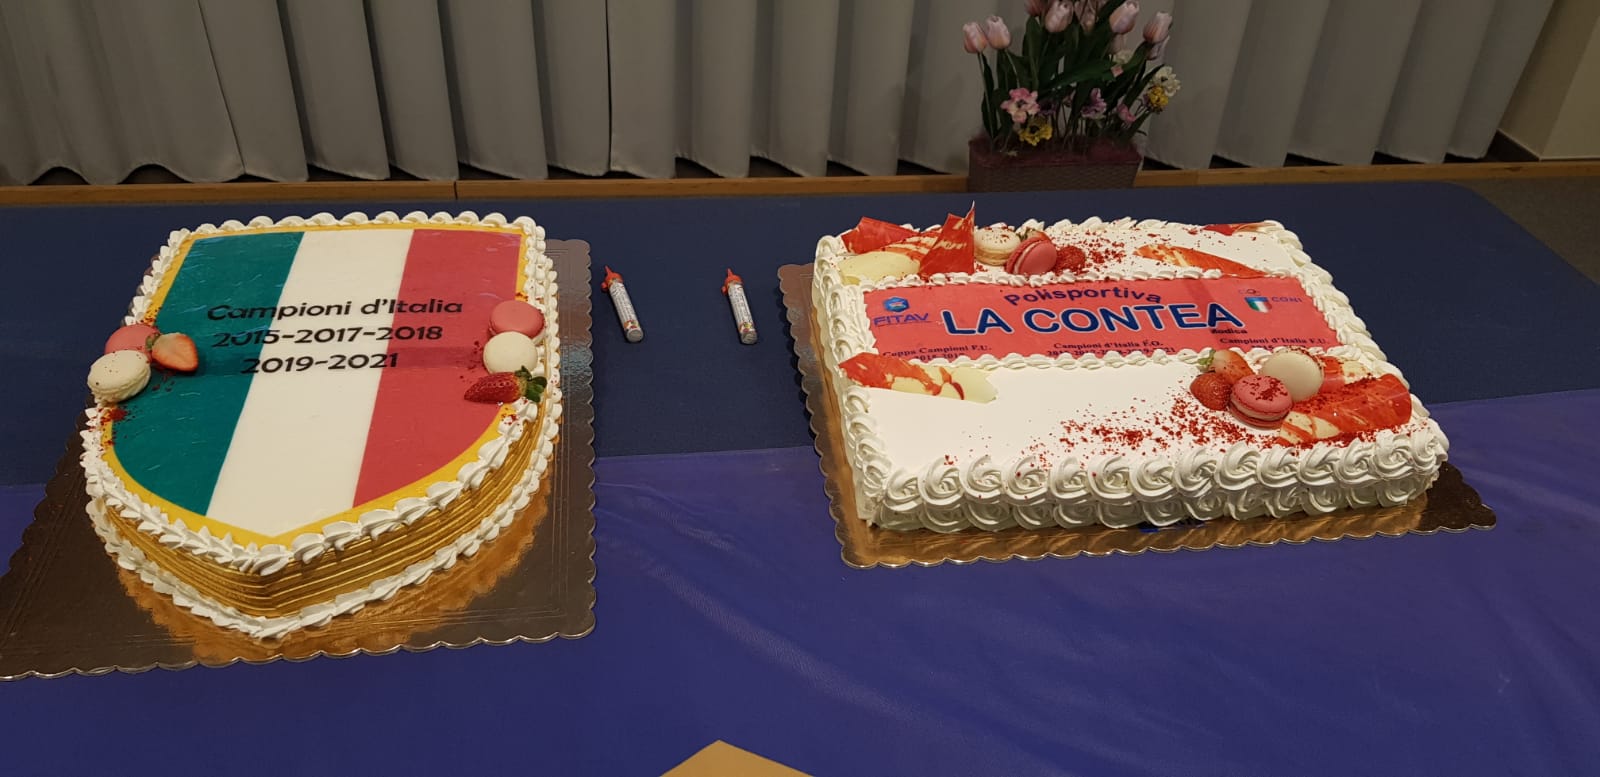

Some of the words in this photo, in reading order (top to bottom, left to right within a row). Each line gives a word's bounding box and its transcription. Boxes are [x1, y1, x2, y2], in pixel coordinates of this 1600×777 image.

[1004, 287, 1162, 305] Polisportiva
[207, 301, 352, 321] Campioni
[360, 298, 463, 315] d'Italia
[873, 313, 930, 326] FITAV
[940, 308, 1015, 335] LA
[1022, 302, 1245, 334] CONTEA
[211, 325, 443, 348] 2015-2017-2018
[240, 353, 399, 375] 2019-2021
